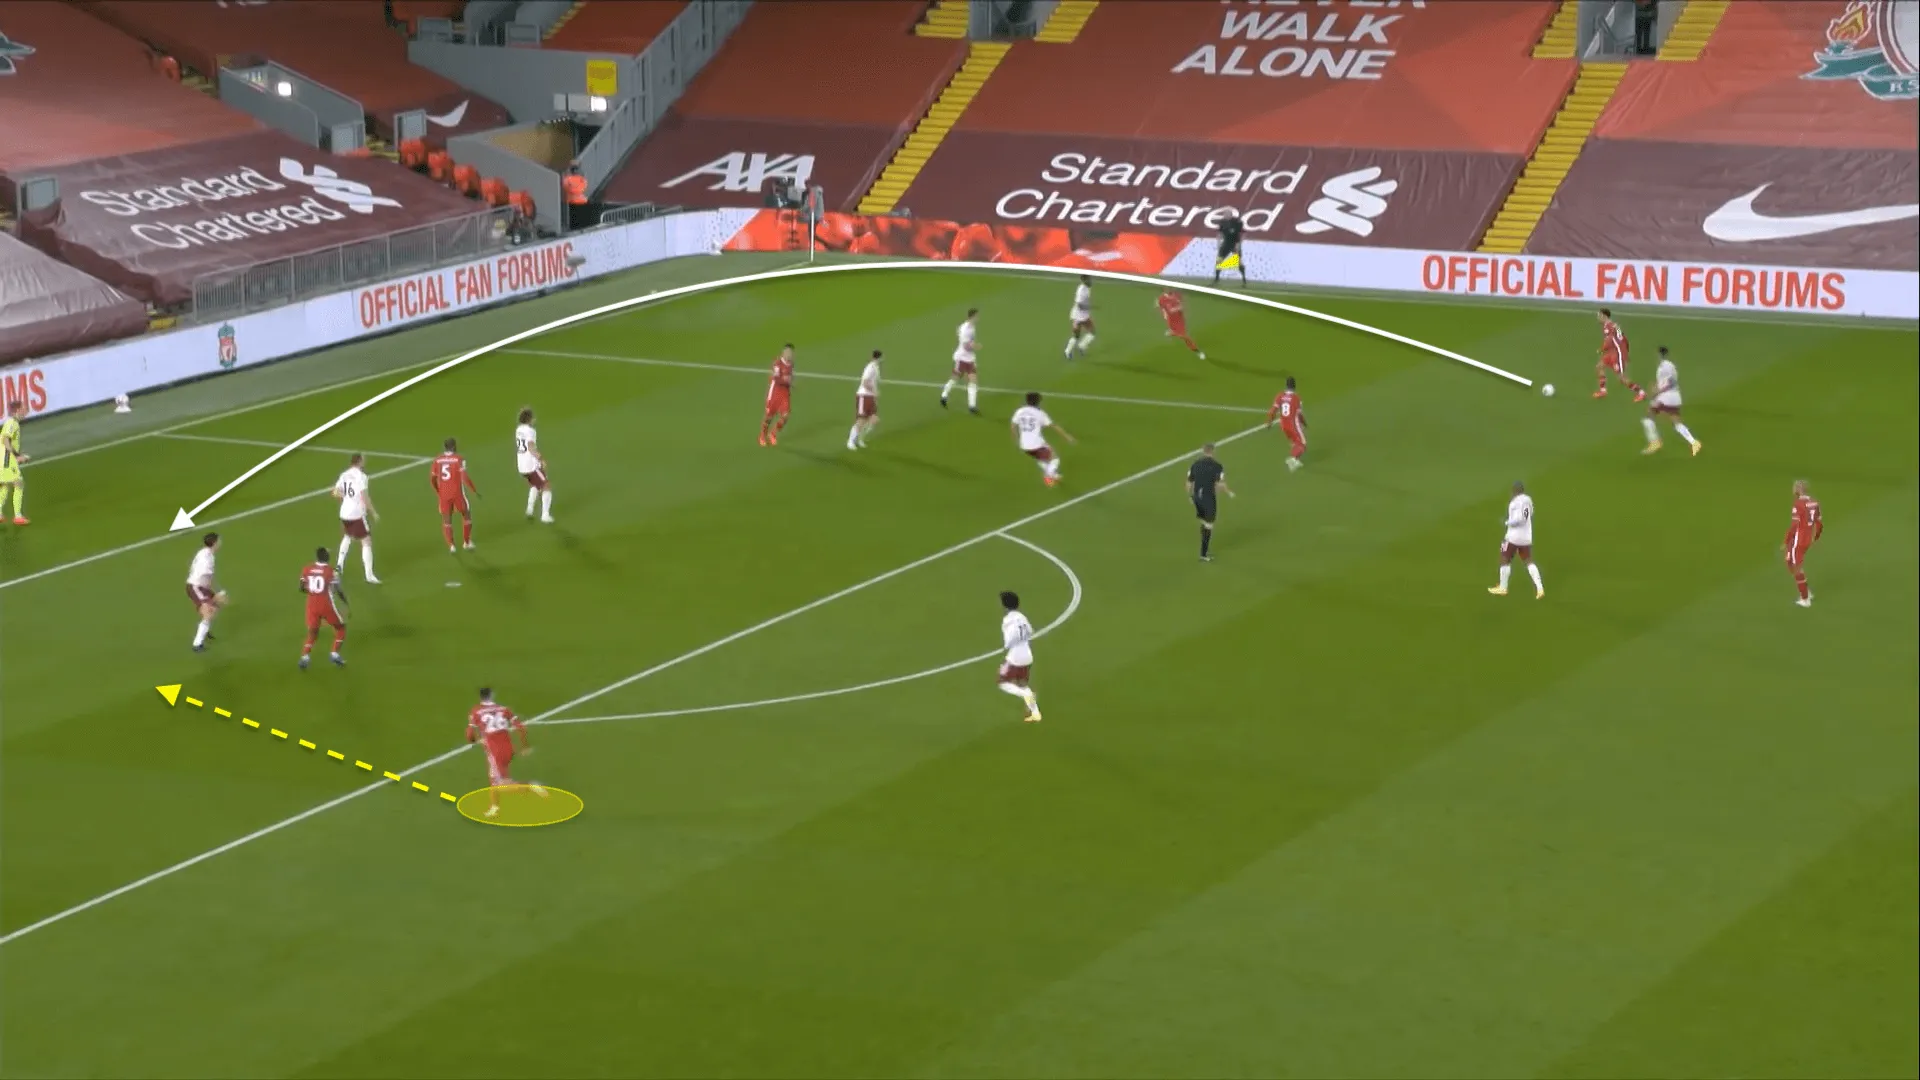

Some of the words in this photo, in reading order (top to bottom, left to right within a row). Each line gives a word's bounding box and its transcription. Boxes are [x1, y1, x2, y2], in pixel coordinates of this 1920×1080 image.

[1220, 10, 1404, 44] WALK
[1171, 44, 1396, 80] ALONE
[80, 165, 286, 216] Standard
[658, 151, 815, 192] AXA
[1041, 152, 1308, 194] Standard
[130, 195, 346, 249] Chartered
[995, 188, 1284, 232] Chartered
[360, 274, 450, 329] OFFICIAL
[455, 261, 493, 304] FAN
[497, 241, 576, 293] FORUMS
[1422, 254, 1583, 298] OFFICIAL
[1598, 263, 1669, 301] FAN
[1683, 267, 1846, 310] FORUMS
[0, 369, 47, 419] MS
[1281, 402, 1290, 417] 8
[343, 481, 355, 498] 16
[441, 463, 452, 481] 5
[307, 575, 325, 594] 10
